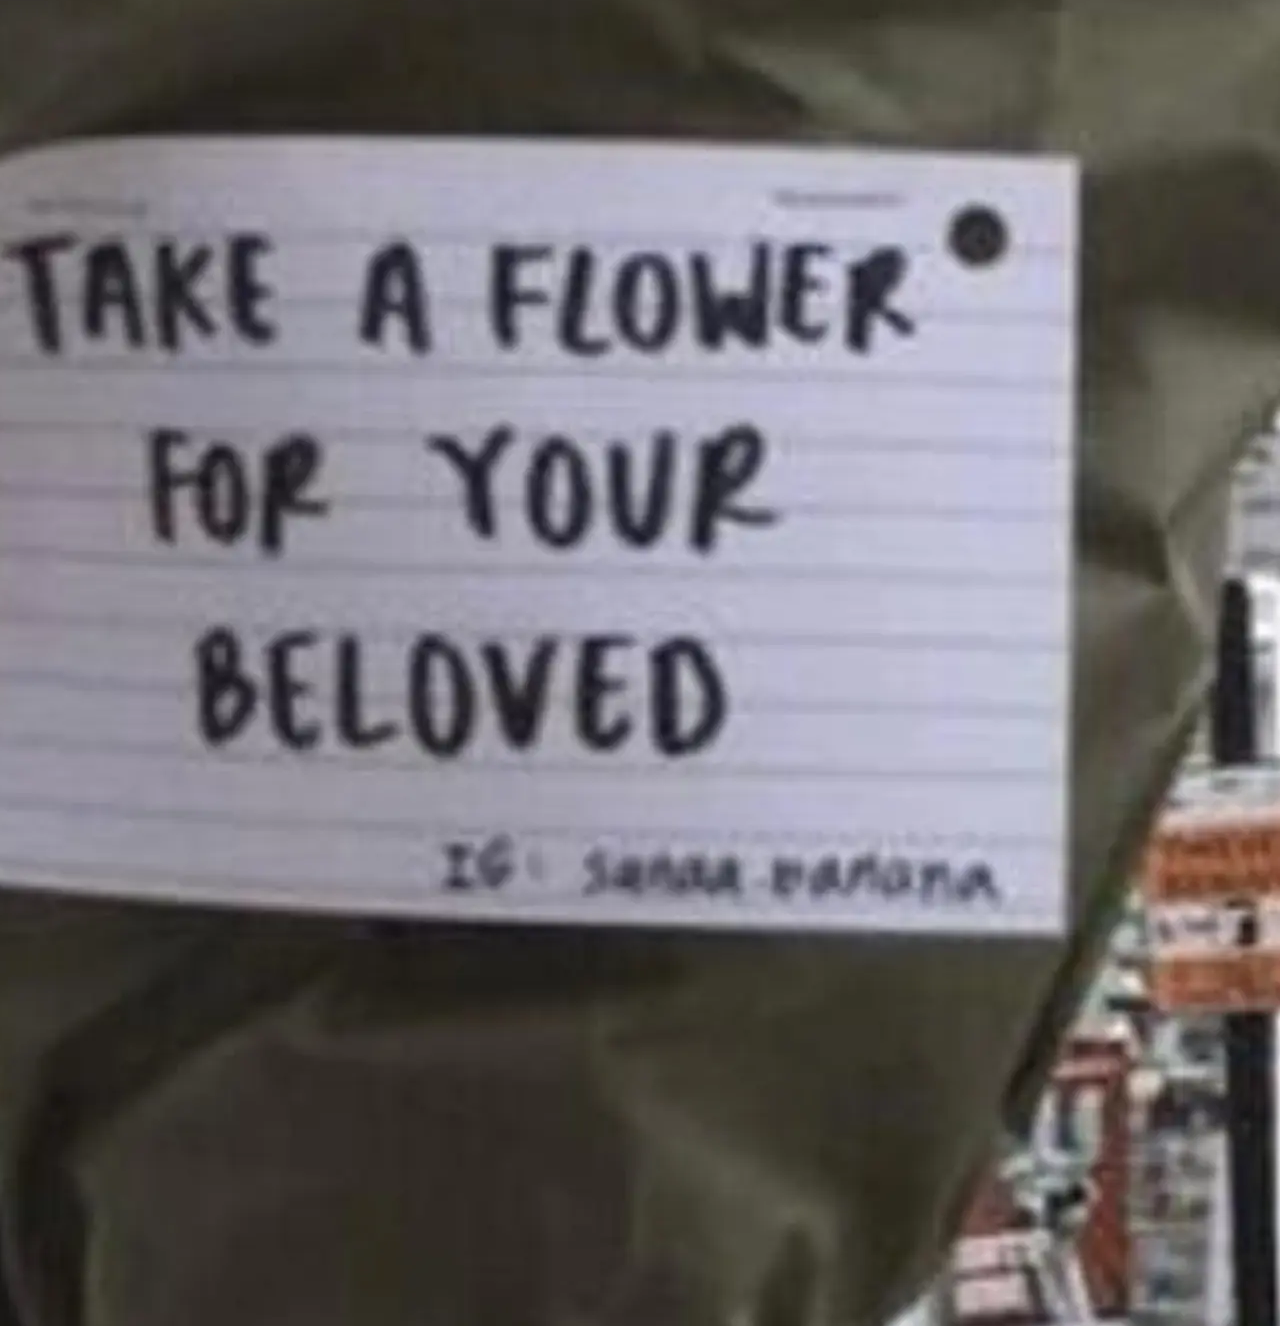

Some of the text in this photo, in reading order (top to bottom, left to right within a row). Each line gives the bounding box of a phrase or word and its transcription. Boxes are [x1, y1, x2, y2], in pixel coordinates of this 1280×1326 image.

[4, 232, 918, 358] TAKE A FLOWER
[147, 422, 783, 557] FOR YOUR
[192, 624, 729, 761] BELOVED
